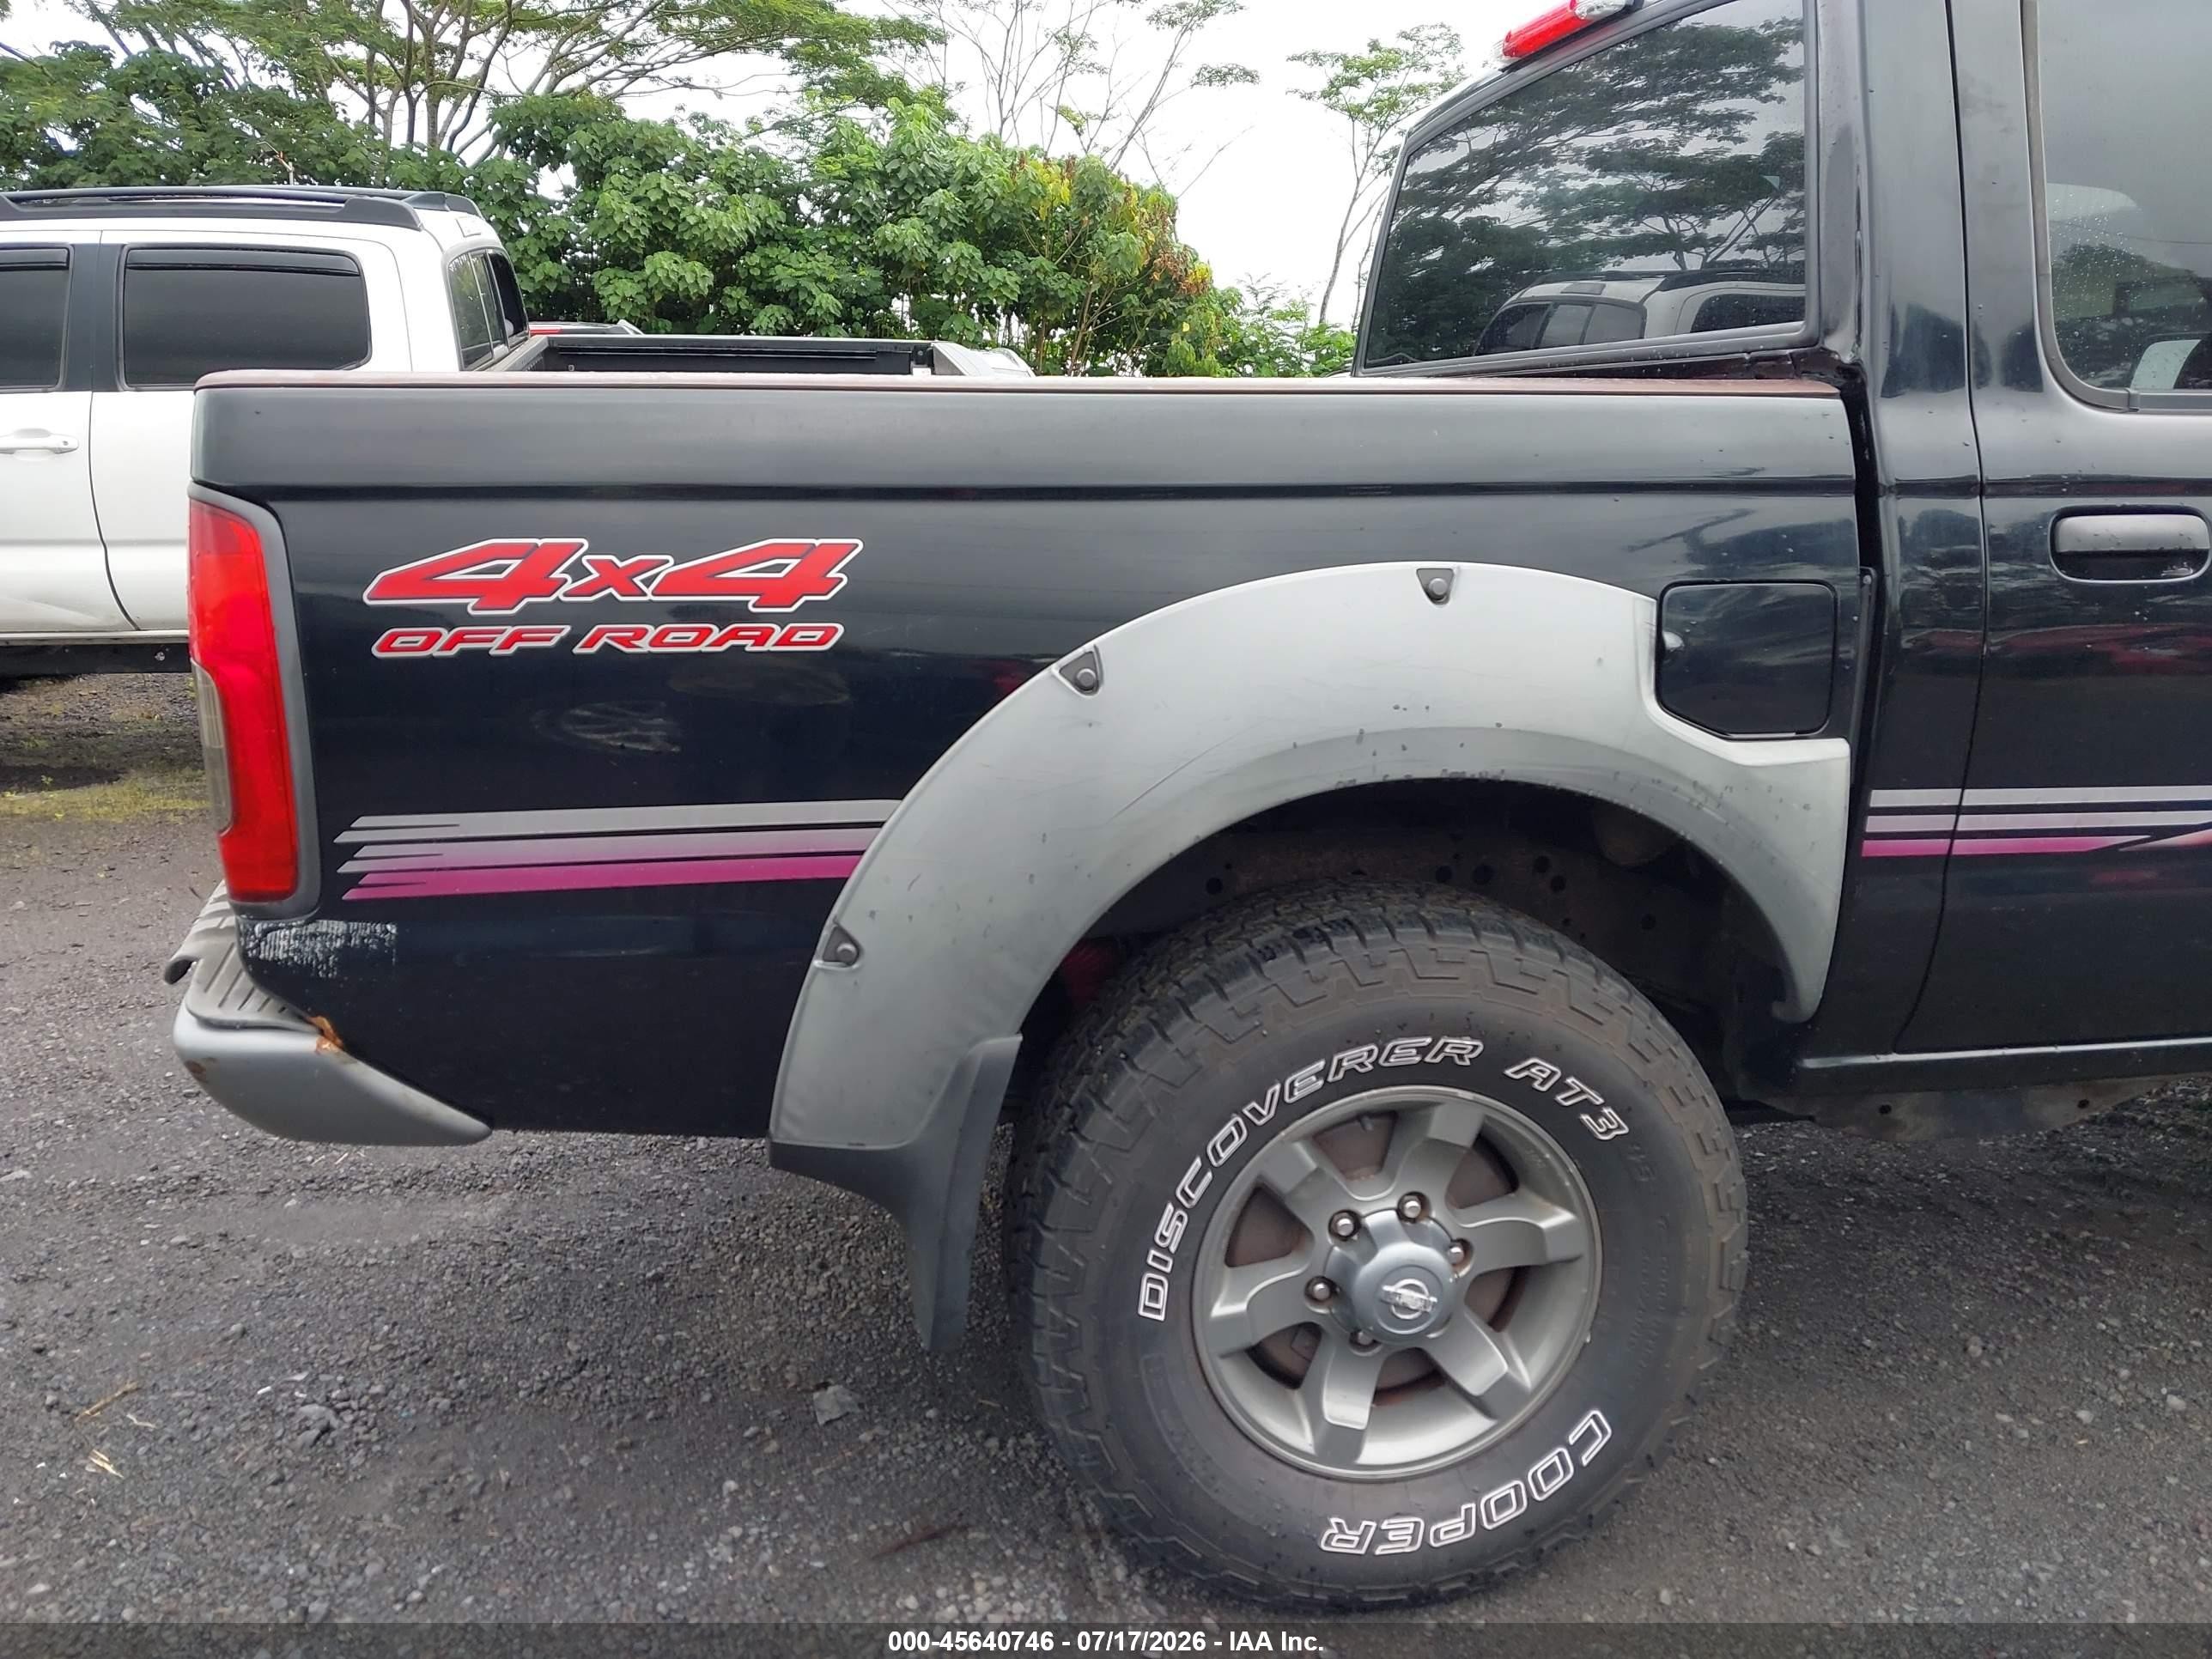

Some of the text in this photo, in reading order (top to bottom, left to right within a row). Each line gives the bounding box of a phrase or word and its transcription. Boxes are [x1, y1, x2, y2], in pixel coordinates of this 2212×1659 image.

[363, 538, 863, 615] 4x4
[372, 623, 845, 658] OFF ROAD
[1138, 1036, 1484, 1322] DISCOVERER
[1504, 1057, 1630, 1141] AT3
[1320, 1409, 1613, 1555] COOPER
